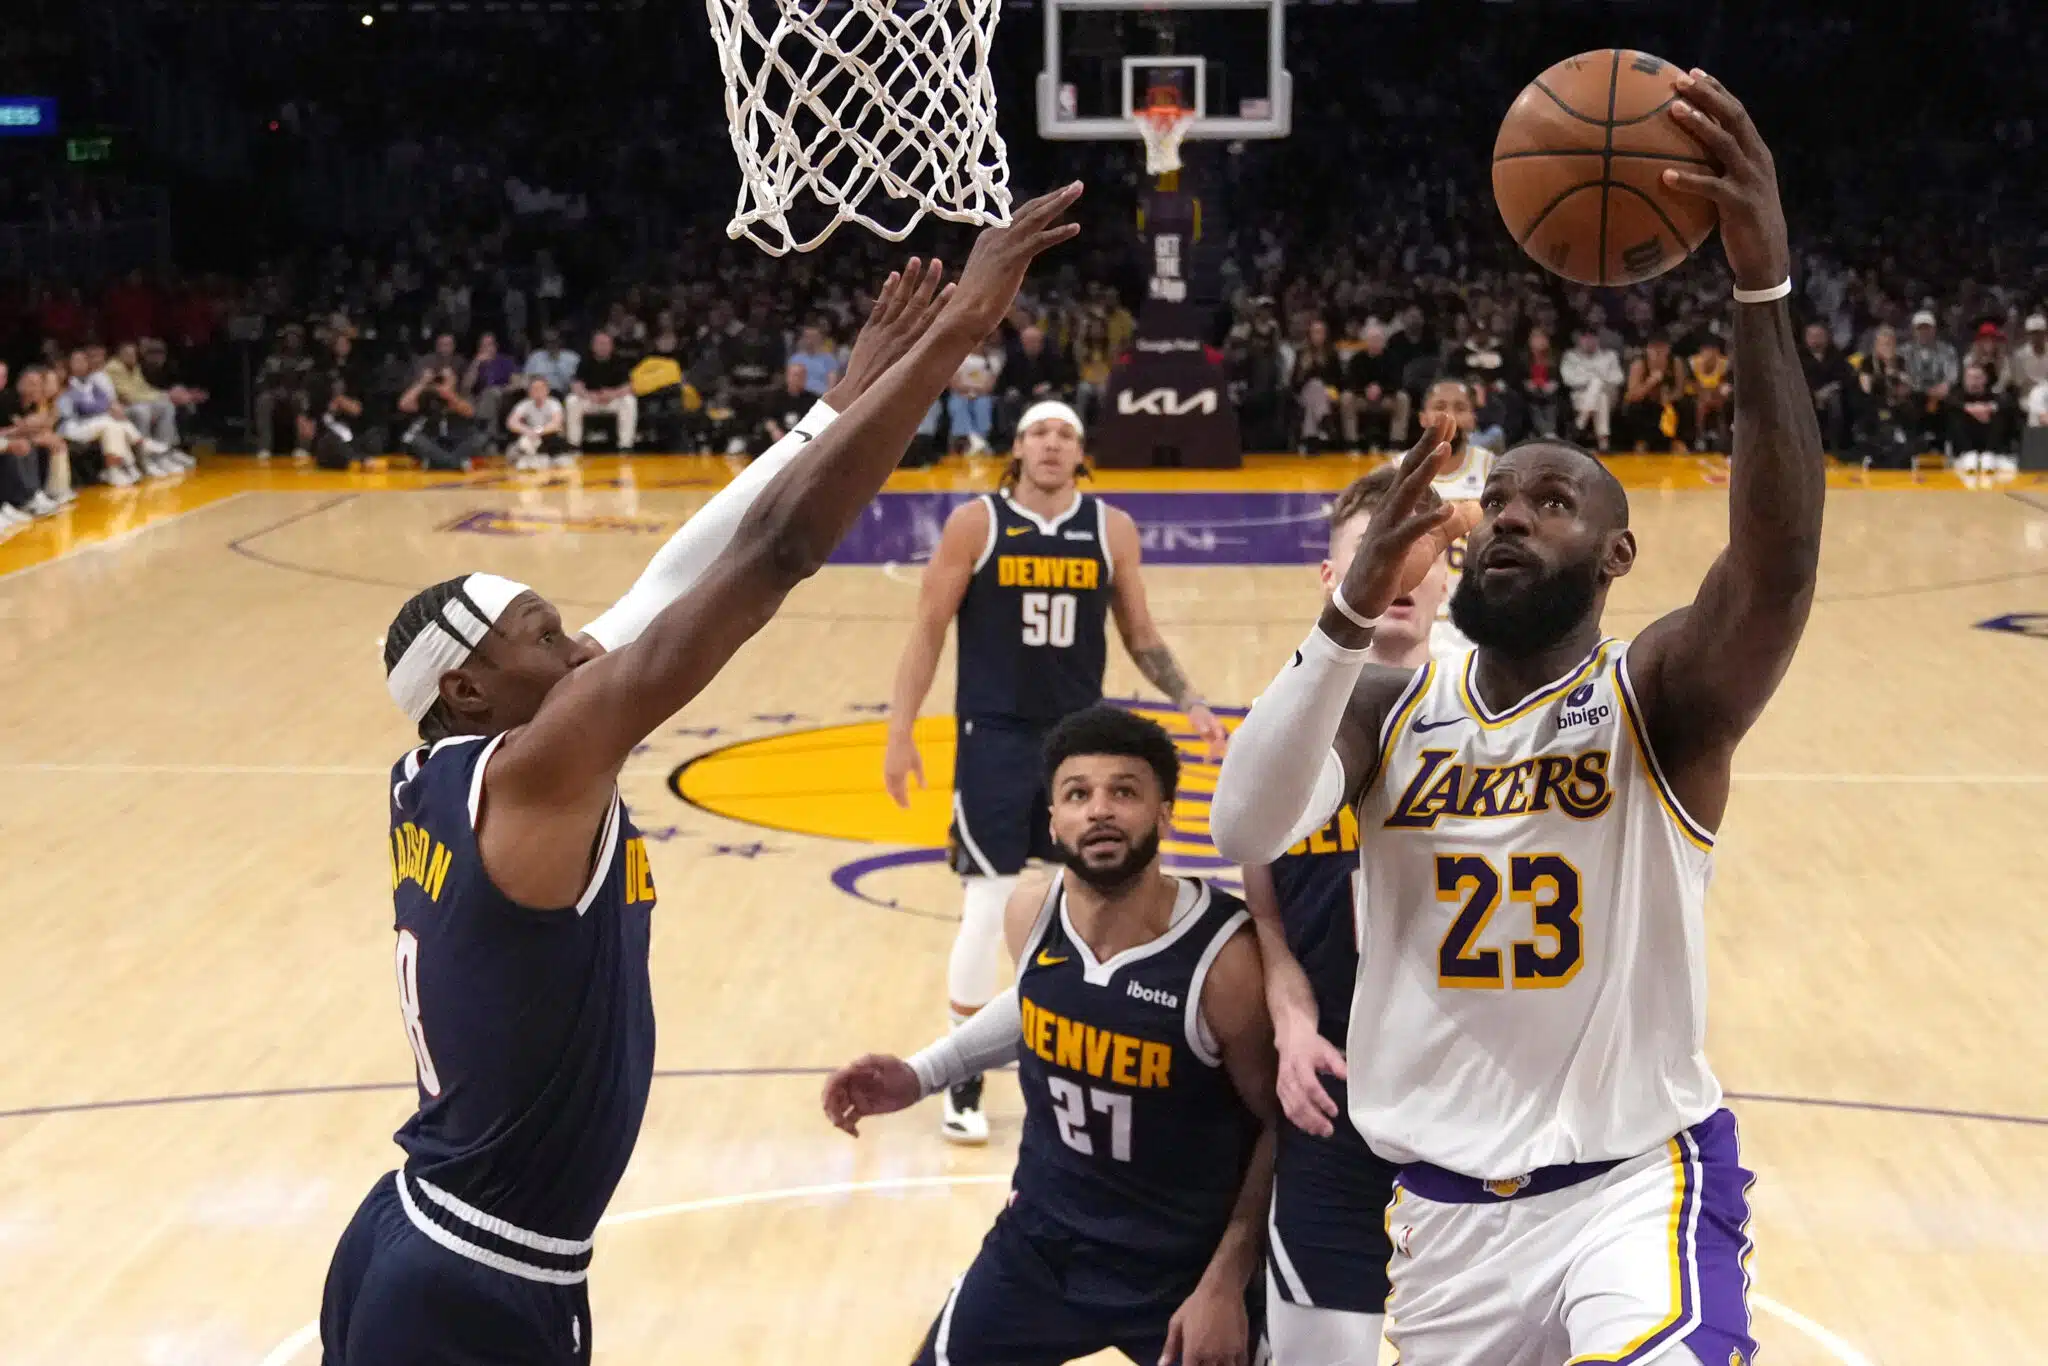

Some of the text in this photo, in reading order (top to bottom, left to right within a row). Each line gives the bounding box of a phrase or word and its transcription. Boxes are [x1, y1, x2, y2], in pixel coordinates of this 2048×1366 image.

[998, 554, 1099, 589] DENVER
[1022, 592, 1077, 648] 50
[1556, 704, 1609, 730] bibigo
[1383, 749, 1616, 831] LAKERS
[1433, 852, 1585, 990] 23
[1126, 979, 1179, 1009] ibotta
[1021, 995, 1173, 1089] DENVER
[1047, 1074, 1132, 1163] 27
